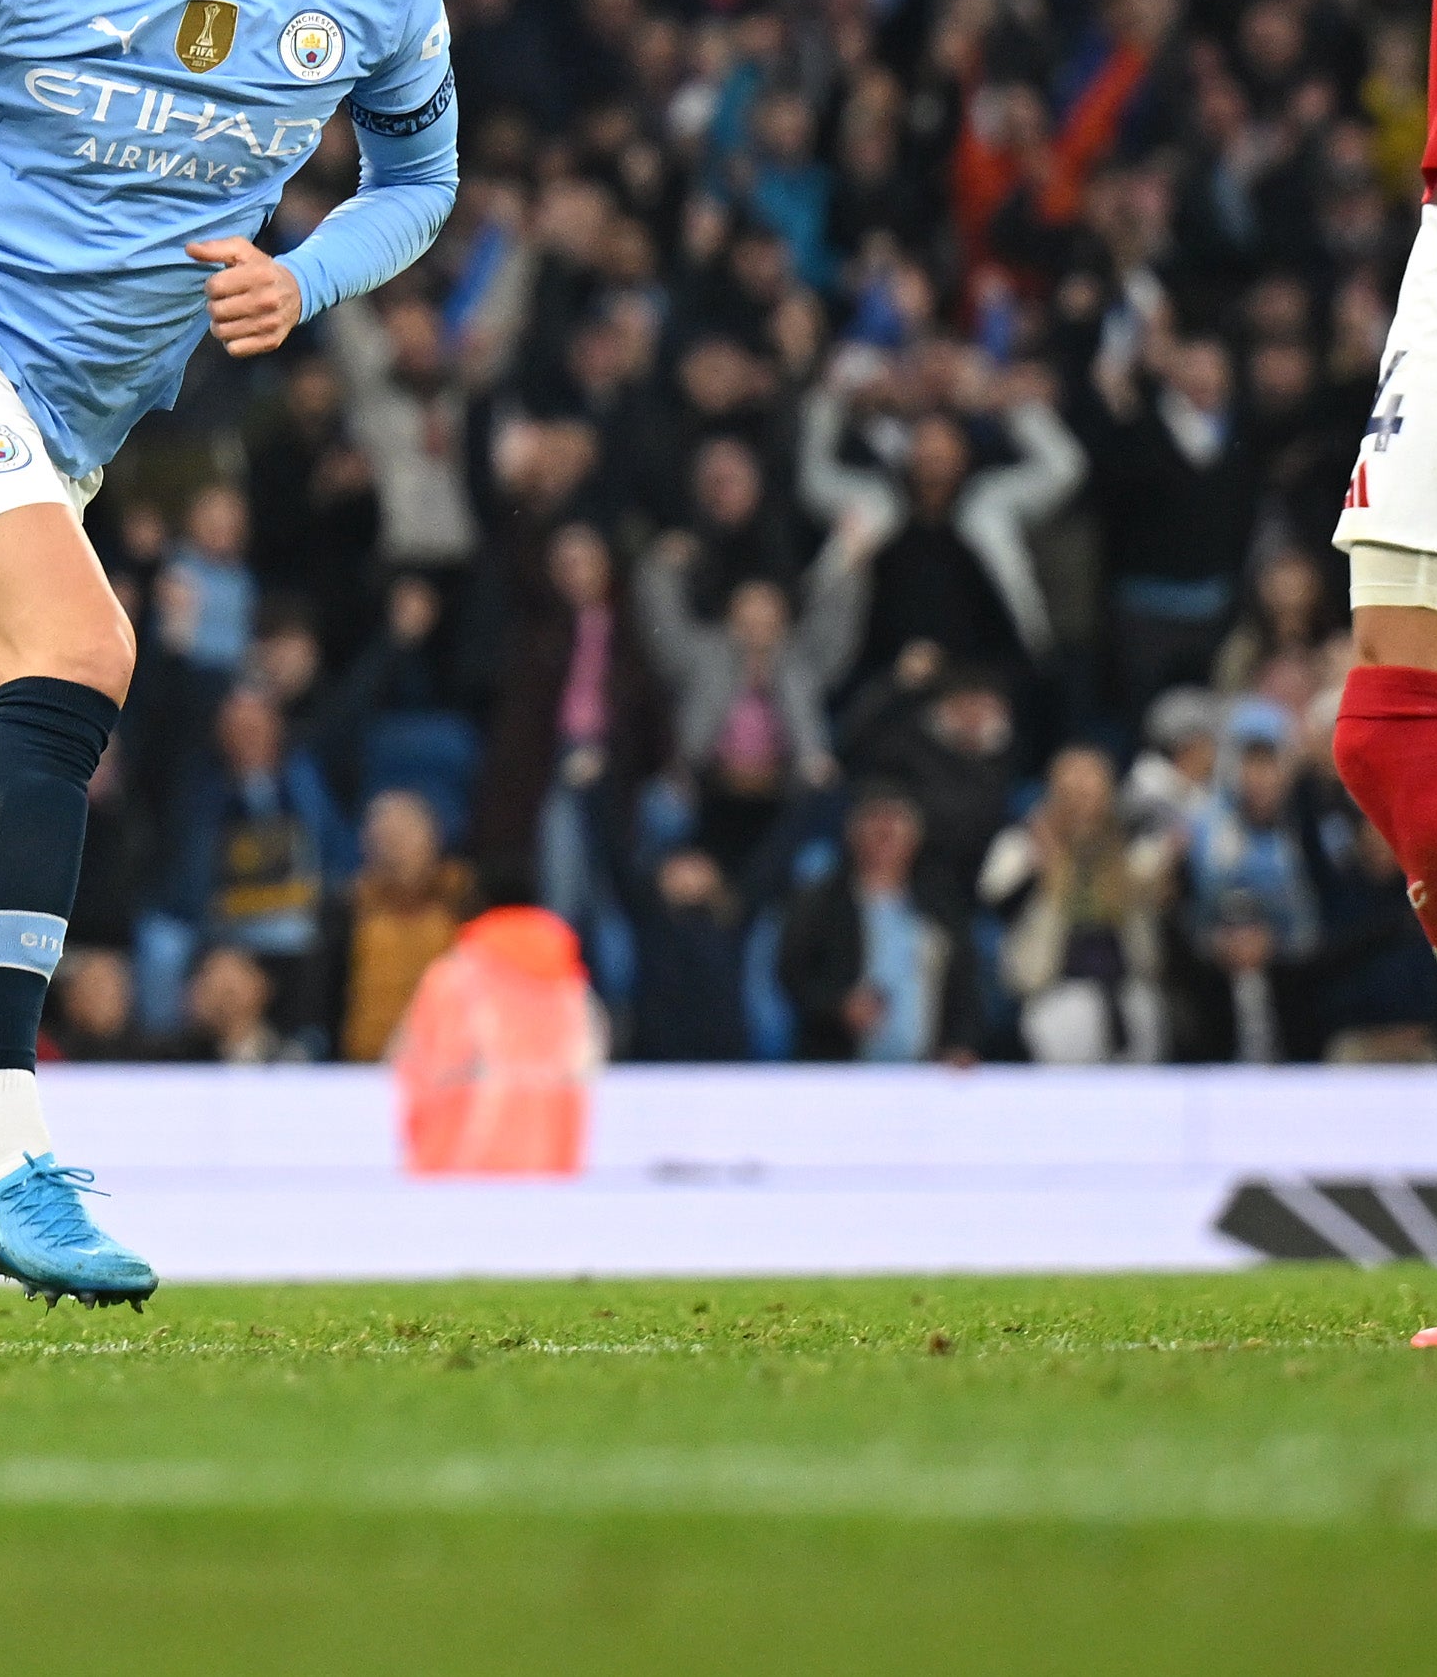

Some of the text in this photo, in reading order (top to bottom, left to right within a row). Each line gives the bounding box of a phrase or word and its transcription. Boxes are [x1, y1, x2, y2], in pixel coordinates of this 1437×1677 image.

[286, 15, 338, 37] MANCHESTER
[189, 44, 214, 58] FIFA
[301, 70, 321, 78] CITY
[24, 67, 322, 158] ETIHAD
[73, 137, 247, 188] AIRWAYS
